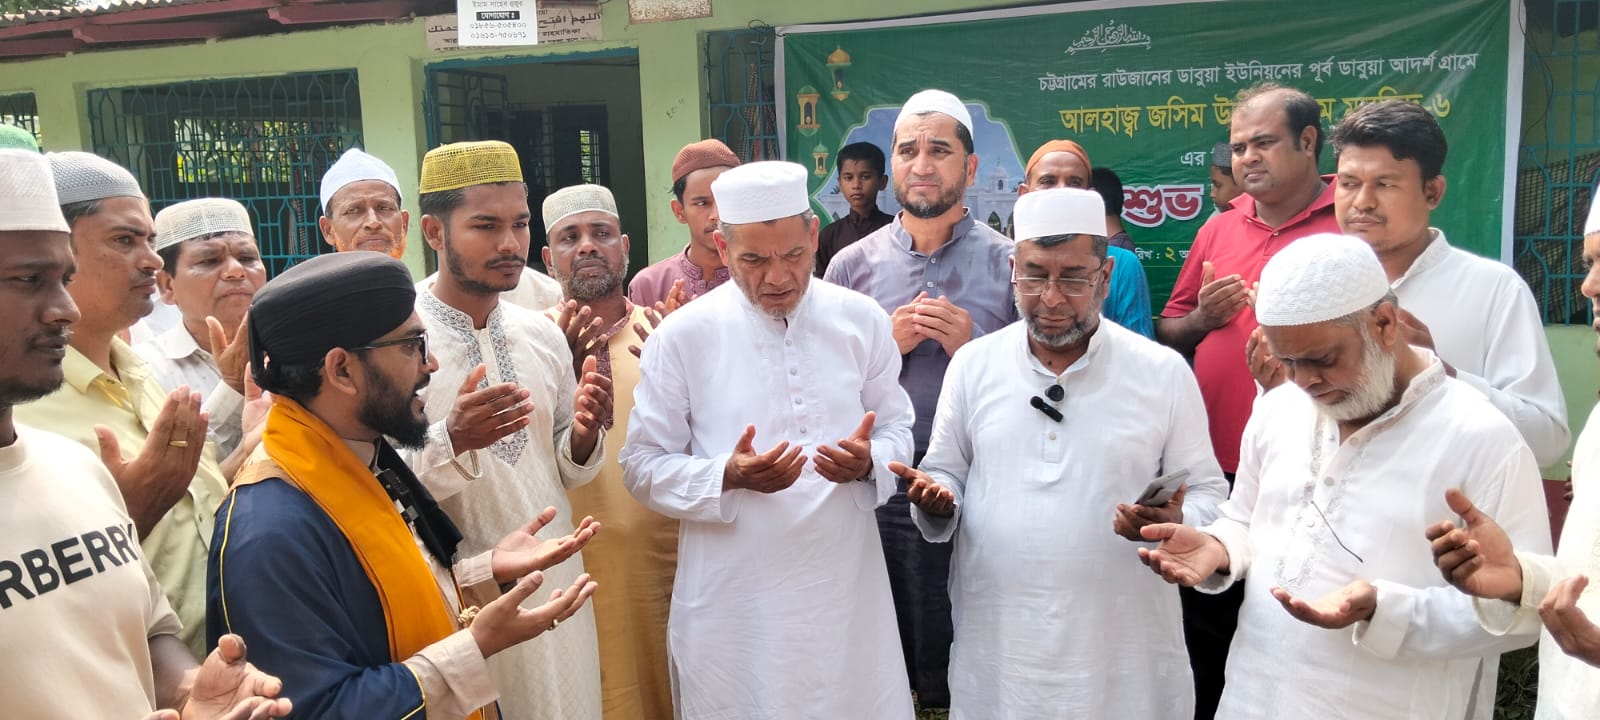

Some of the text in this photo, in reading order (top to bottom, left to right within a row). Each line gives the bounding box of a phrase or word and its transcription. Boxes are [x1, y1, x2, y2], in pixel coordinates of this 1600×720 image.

[1038, 50, 1479, 92] চট্টগ্রামের রাউজানের ডাবুয়া ইউনিয়নের পূর্ব ডাবুয়া আদর্শ গ্রামে
[1058, 105, 1142, 139] আলহাজ্ব
[1146, 95, 1208, 130] জসিম
[1180, 151, 1206, 167] এর
[1120, 184, 1205, 228] শুভ
[1164, 247, 1176, 262] ২
[0, 523, 139, 610] RBERRY
